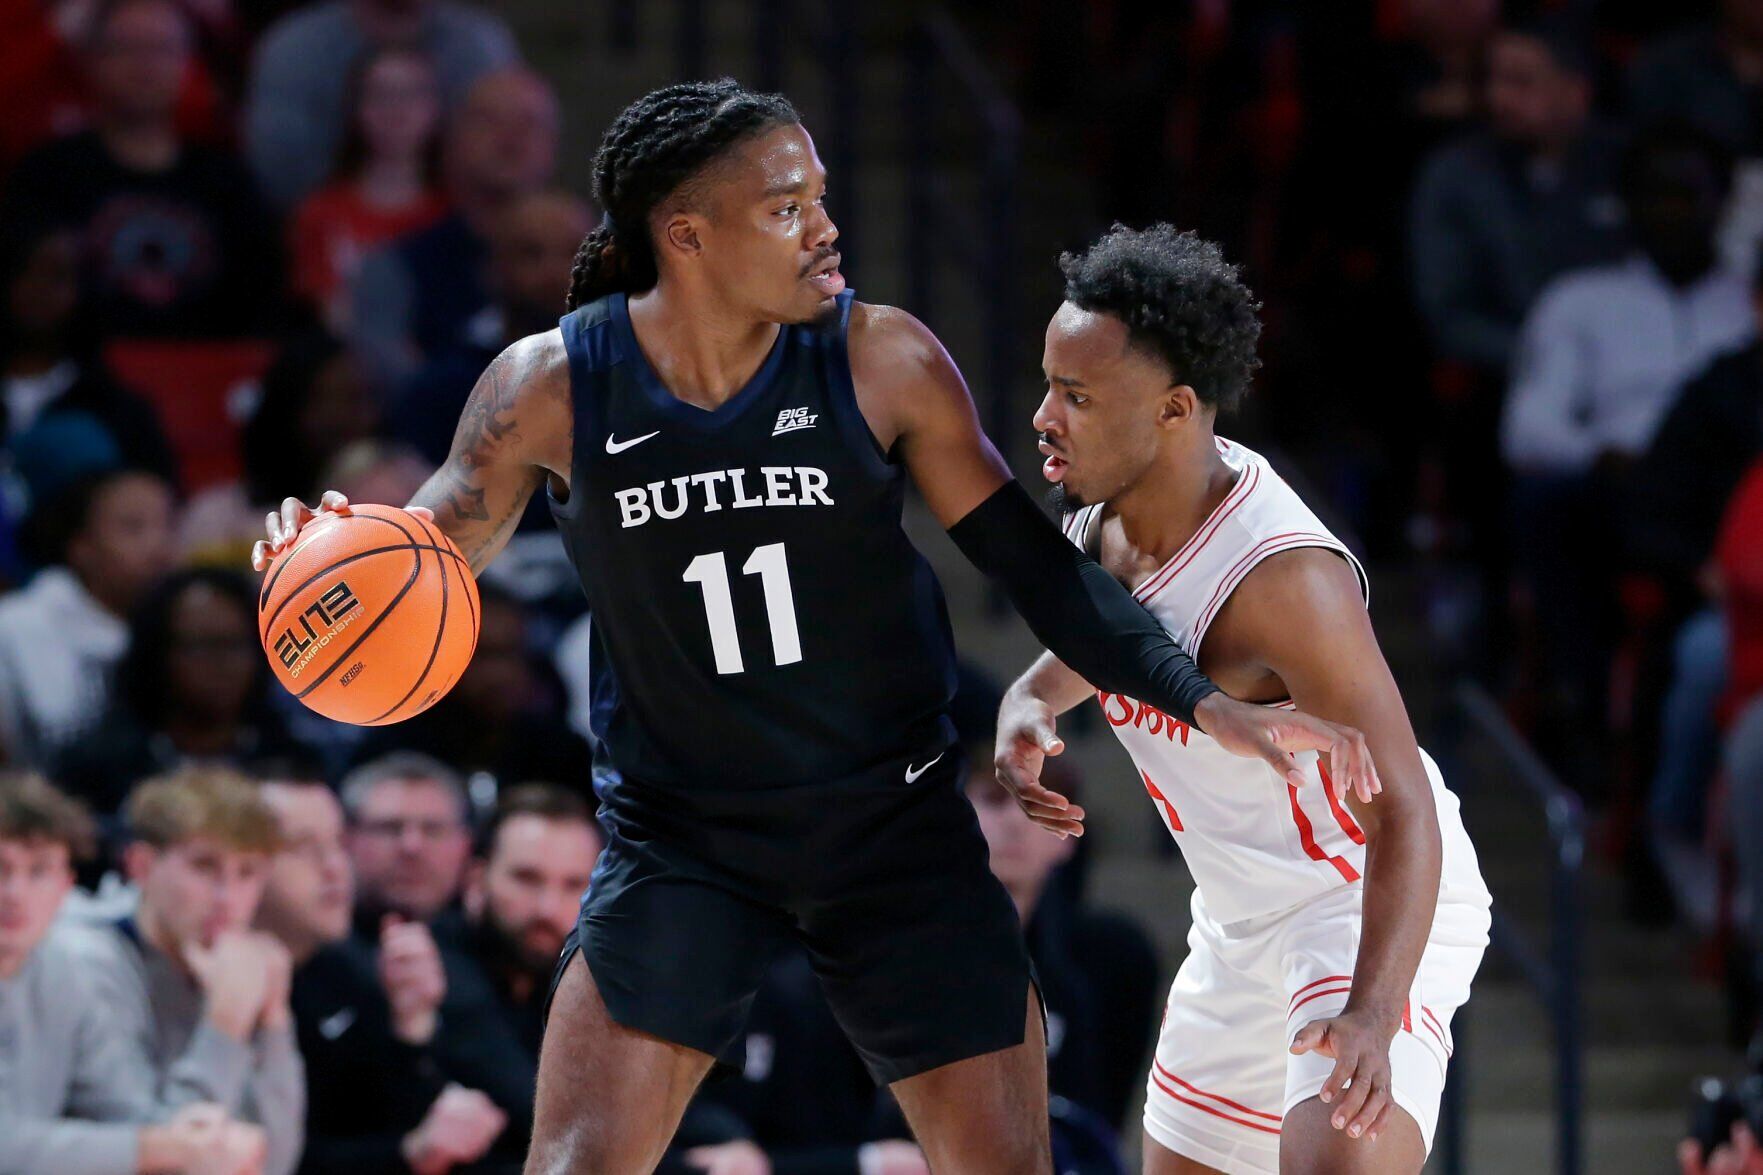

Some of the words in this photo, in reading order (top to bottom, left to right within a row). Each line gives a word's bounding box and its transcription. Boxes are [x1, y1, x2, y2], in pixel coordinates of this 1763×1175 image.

[773, 414, 819, 431] EAST
[777, 406, 809, 420] BIG
[614, 466, 835, 528] BUTLER
[273, 580, 359, 671] ELITE
[682, 542, 802, 675] 11
[291, 606, 365, 679] CHAMPIONSHIP
